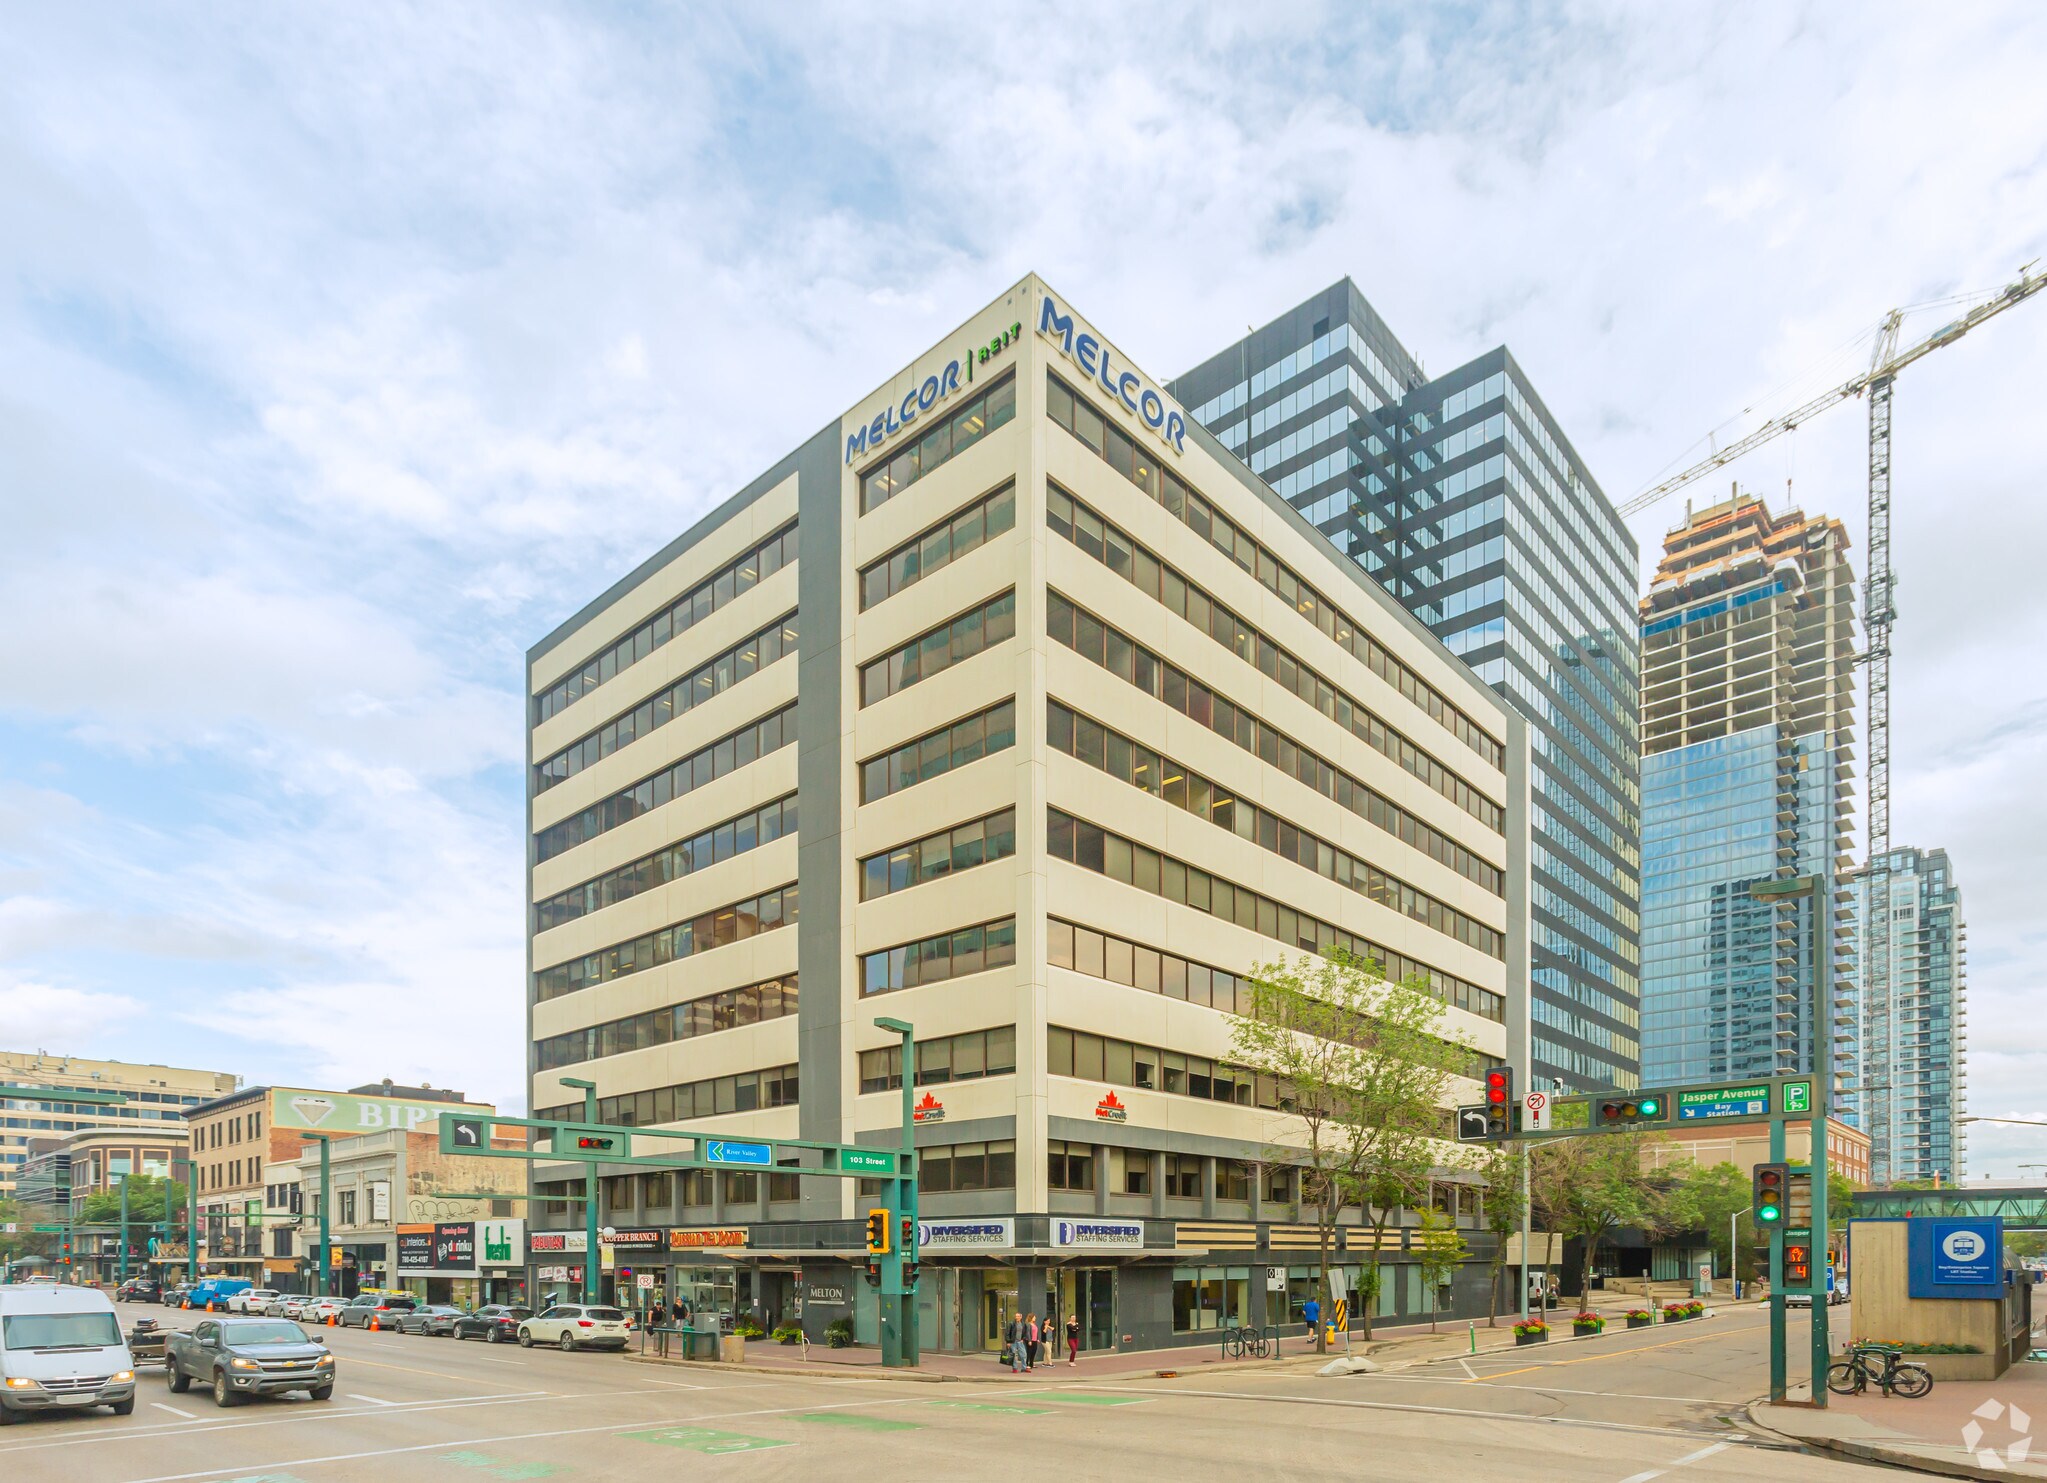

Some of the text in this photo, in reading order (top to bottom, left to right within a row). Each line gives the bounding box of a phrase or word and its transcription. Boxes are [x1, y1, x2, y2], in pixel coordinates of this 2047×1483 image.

[1035, 296, 1186, 457] MELCOR
[845, 321, 1022, 465] MELCOR REIT
[1682, 1088, 1766, 1103] Jasper Avenue
[1706, 1110, 1741, 1118] Station
[850, 1156, 886, 1166] 103 Street
[931, 1224, 1004, 1236] DIVERSIFIED
[1076, 1224, 1141, 1236] DIVERSIFIED
[531, 1235, 563, 1250] FABUTAN
[630, 1232, 657, 1242] BRANCH
[932, 1233, 1004, 1243] STAFFING SERVICES
[1075, 1234, 1139, 1243] STAFFING SERVICES
[448, 1239, 472, 1252] dorinku
[1795, 1265, 1807, 1278] 4
[810, 1288, 843, 1298] MELTON
